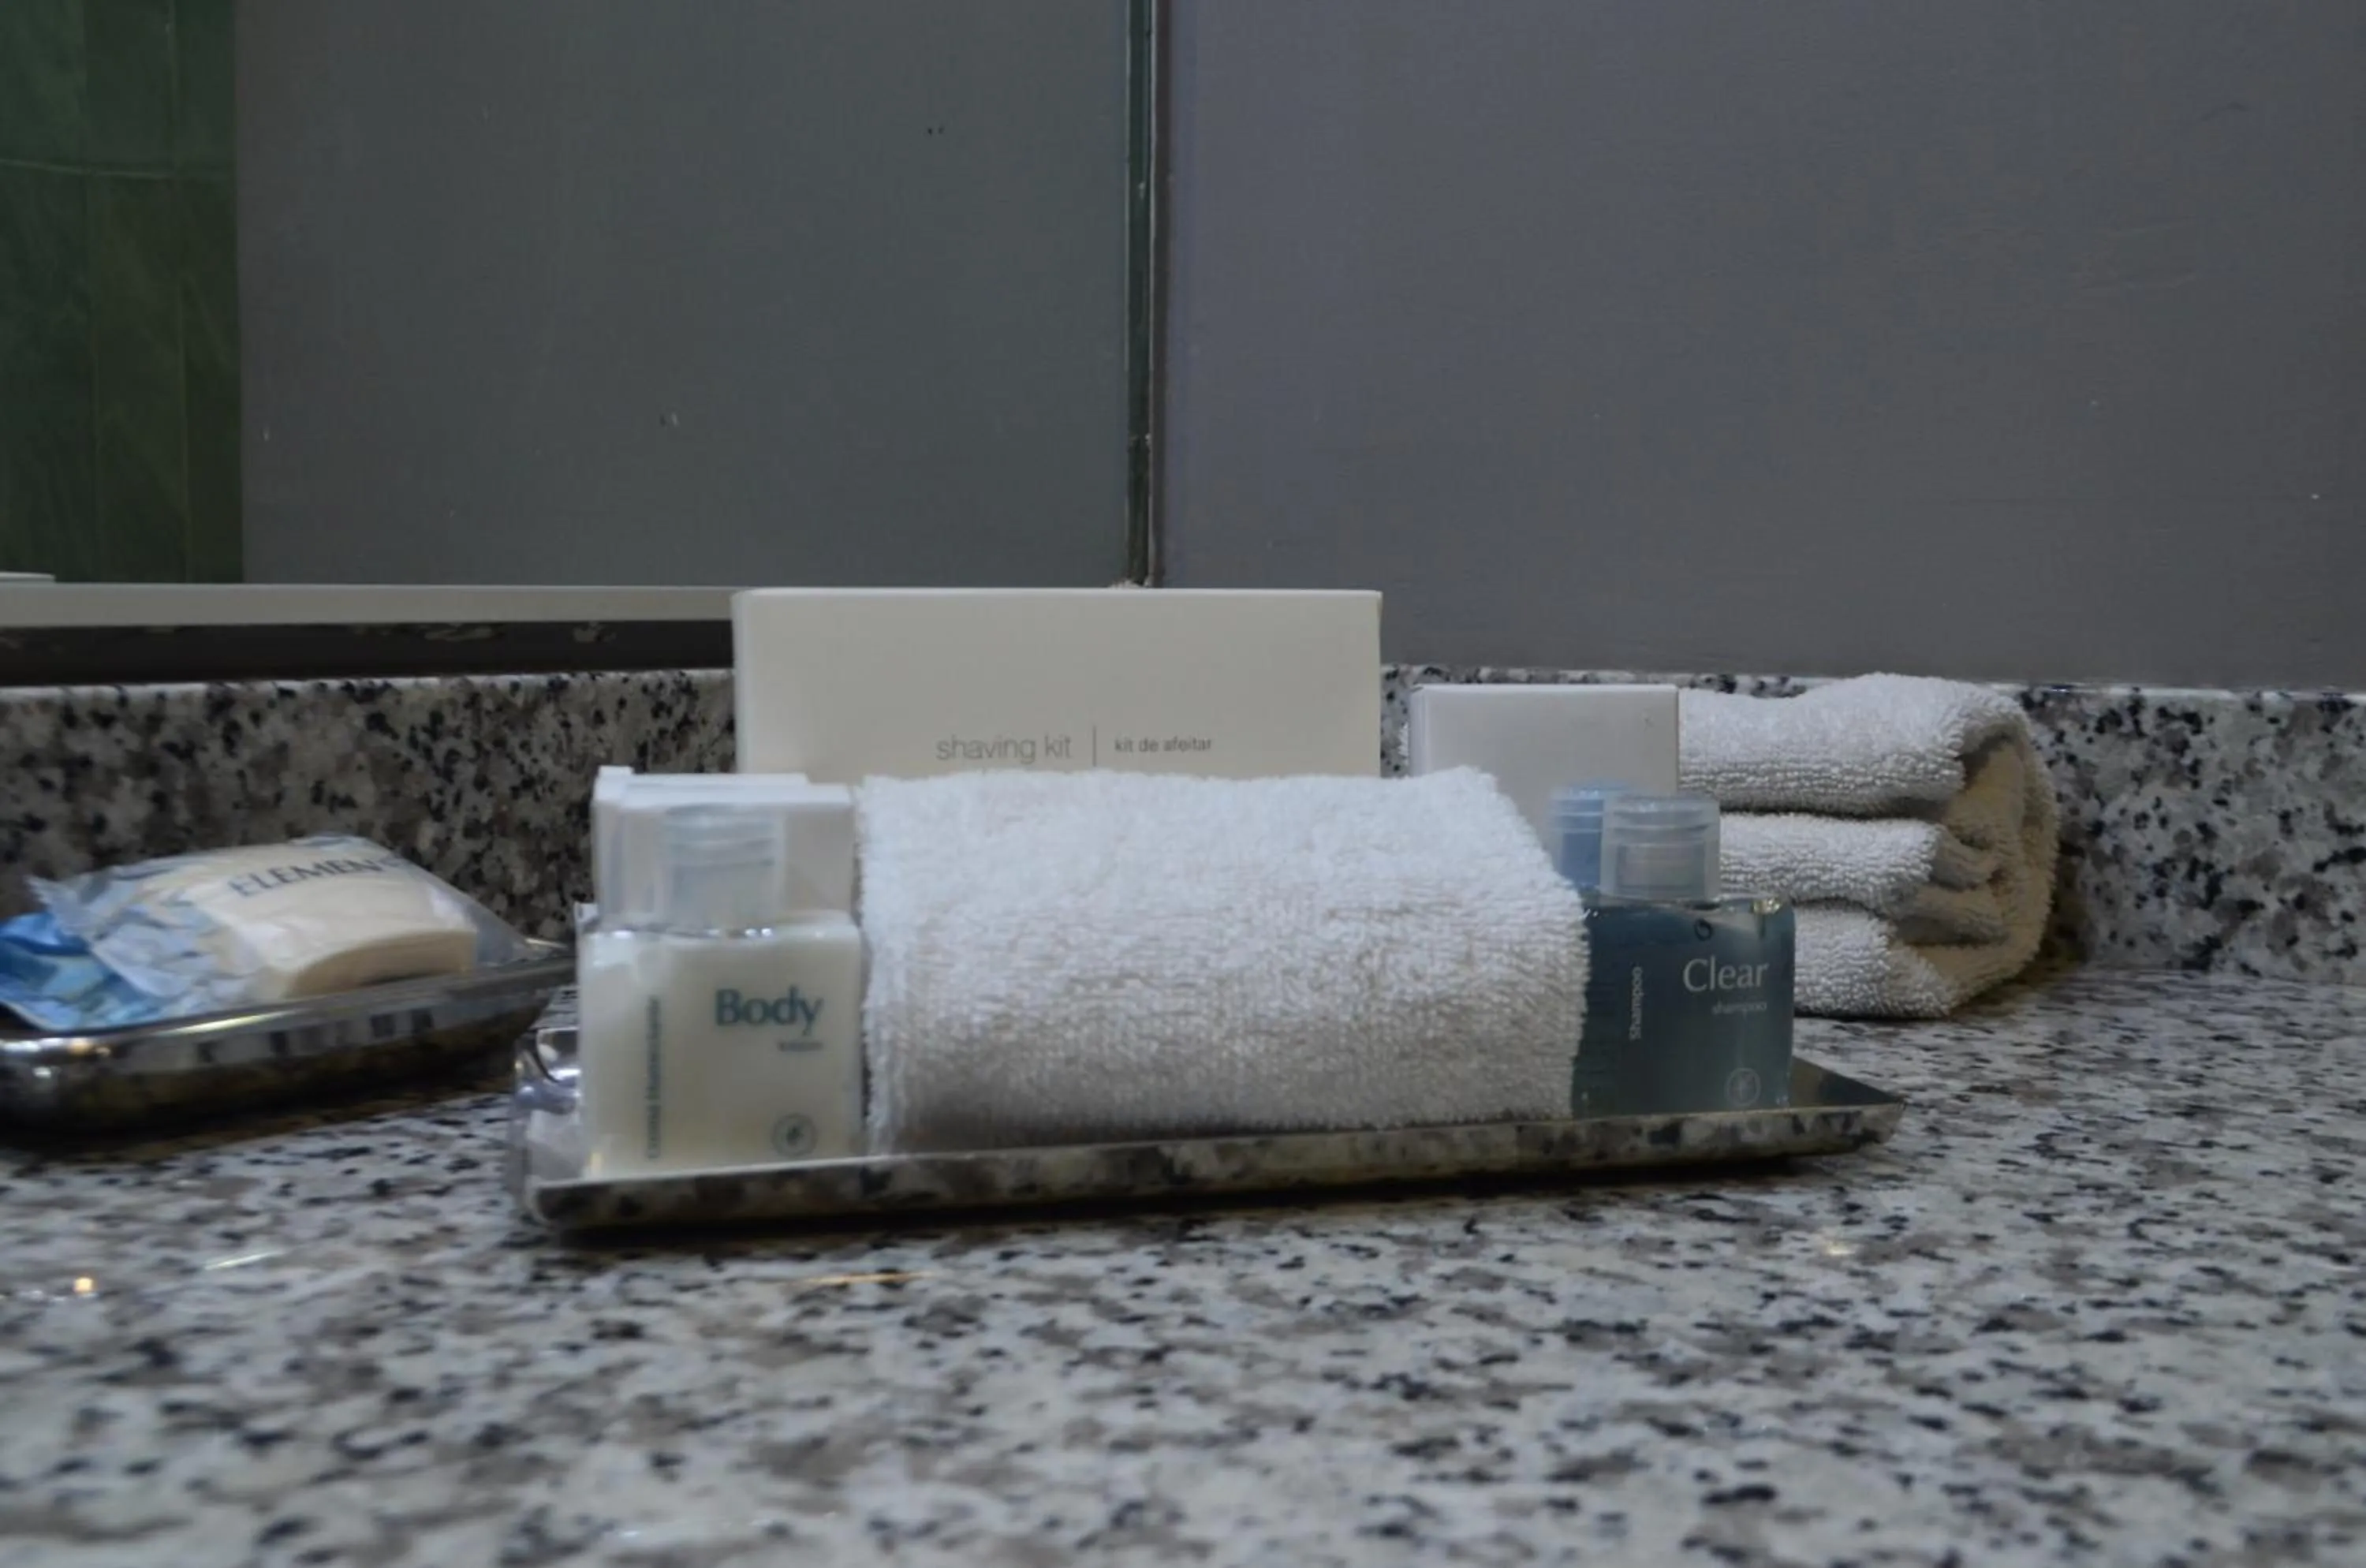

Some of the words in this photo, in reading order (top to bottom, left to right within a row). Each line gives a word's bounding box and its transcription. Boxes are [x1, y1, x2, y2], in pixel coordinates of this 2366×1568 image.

[935, 734, 1037, 764] shaving
[1044, 734, 1073, 759] kit
[1114, 736, 1134, 753] kit
[1138, 736, 1160, 753] de
[1162, 735, 1213, 753] afeitar
[1682, 954, 1770, 993] Clear
[714, 984, 825, 1036] Body
